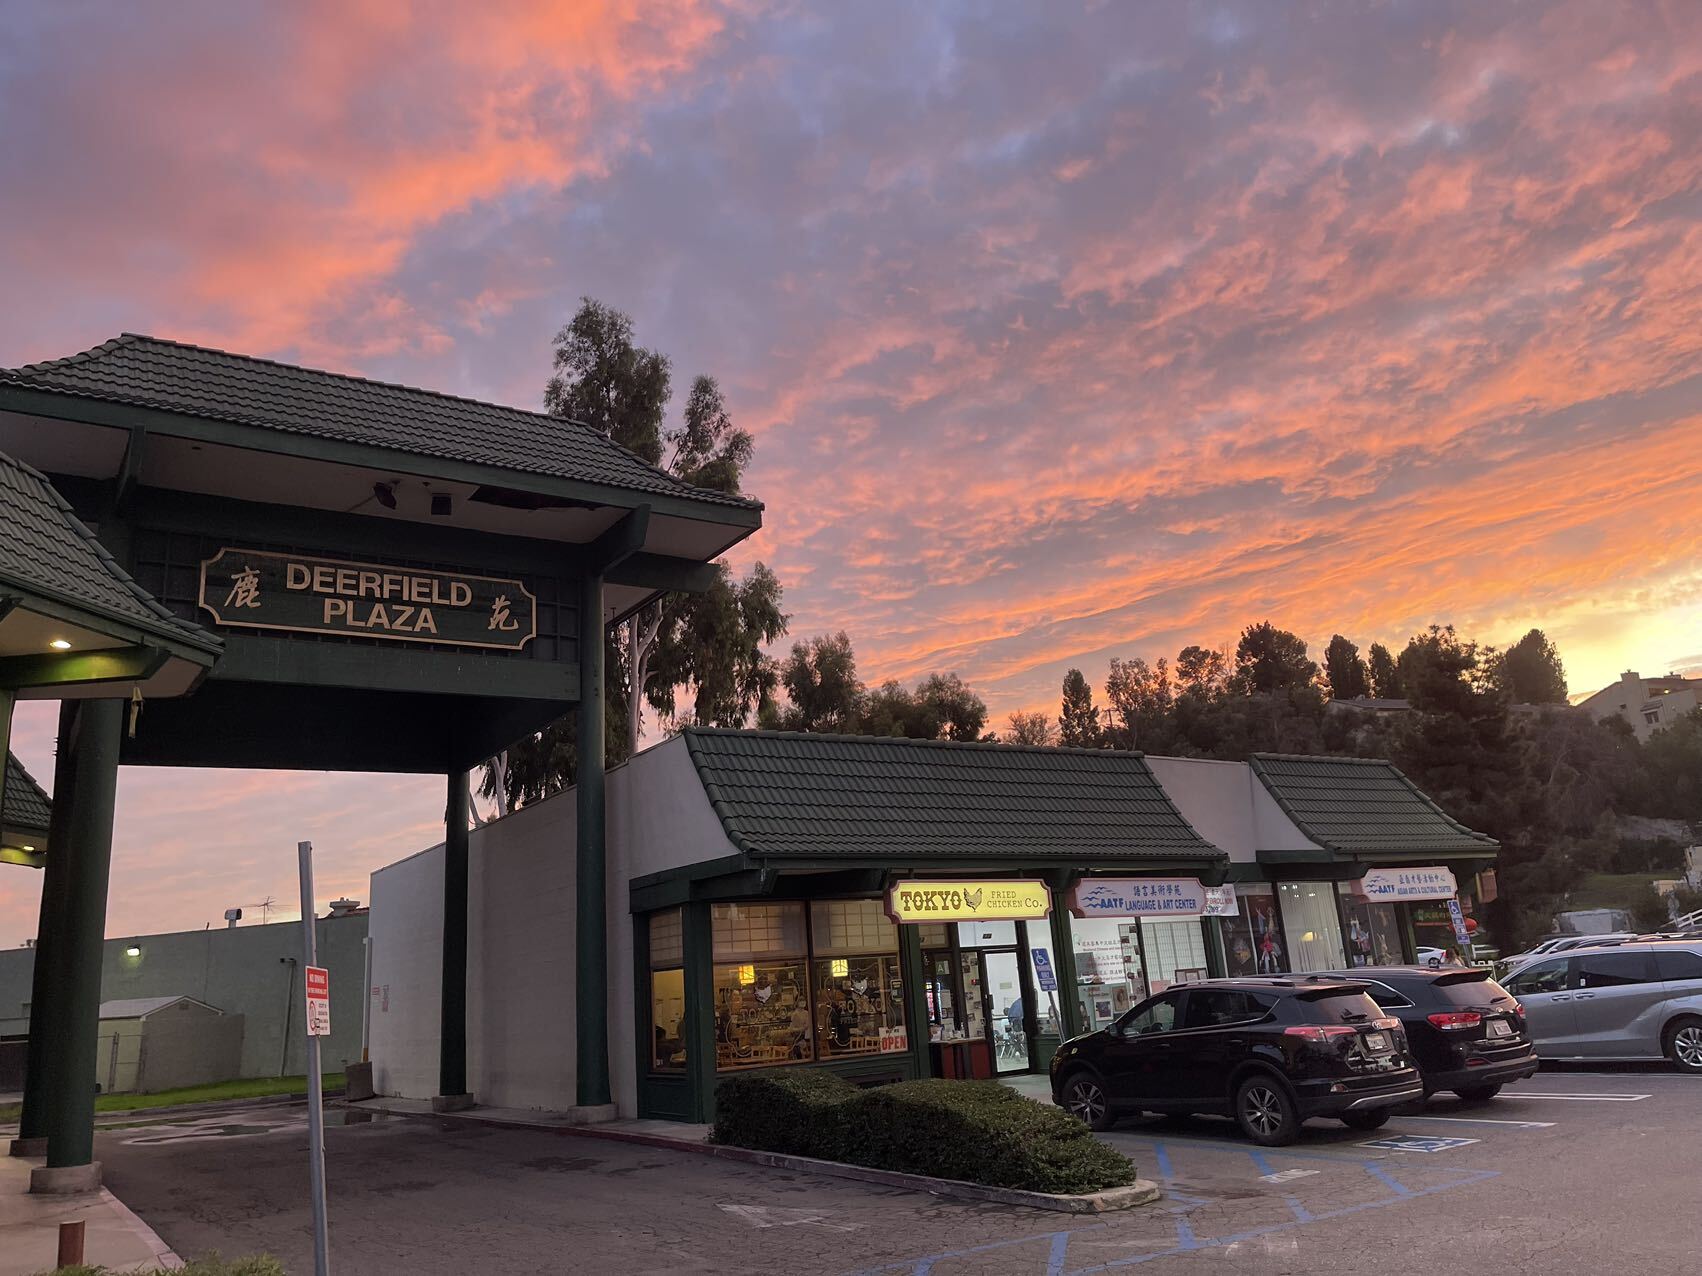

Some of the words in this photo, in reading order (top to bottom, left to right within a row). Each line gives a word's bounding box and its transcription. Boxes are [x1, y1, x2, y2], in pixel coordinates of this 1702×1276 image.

[224, 566, 262, 608] 鹿
[285, 563, 473, 607] DEERFIELD
[323, 598, 438, 634] PLAZA
[991, 890, 1017, 899] FRIED
[1378, 885, 1395, 894] AATF
[1421, 886, 1439, 895] CULTURAL
[1438, 885, 1452, 893] CENTER
[900, 890, 962, 912] TOKYO
[987, 899, 1023, 909] CHICKEN
[1024, 897, 1043, 909] Co.
[1100, 897, 1125, 909] AATF
[1125, 899, 1156, 911] LANGUAGE
[1157, 900, 1162, 910] &
[1163, 899, 1174, 910] ART
[1175, 898, 1197, 910] CENTER
[882, 1035, 906, 1051] OPEN
